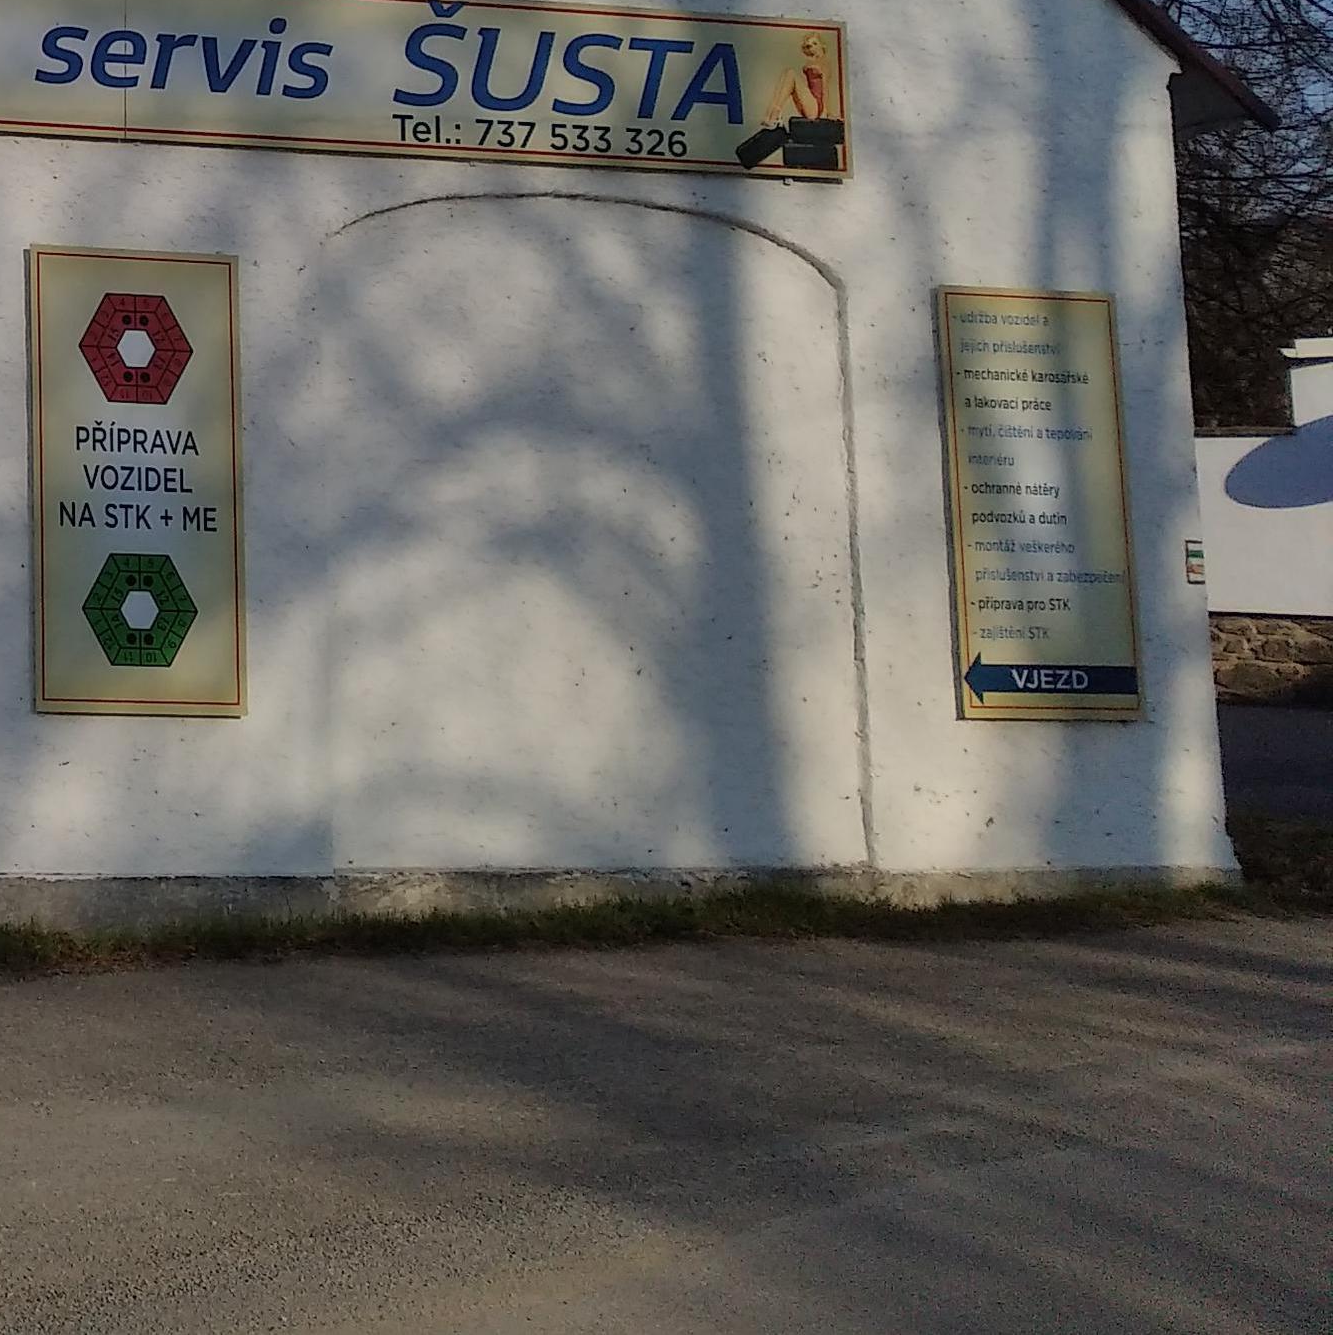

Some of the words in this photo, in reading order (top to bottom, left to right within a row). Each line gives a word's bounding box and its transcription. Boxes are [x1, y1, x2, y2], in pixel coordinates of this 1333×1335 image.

[34, 17, 334, 100] servis
[392, 113, 461, 145] Tel.:
[475, 118, 536, 148] 737
[550, 123, 612, 153] 533
[625, 127, 688, 158] 326
[75, 420, 199, 456] PŘÍPRAVA
[83, 464, 193, 493] VOZIDEL
[59, 501, 96, 527] NA
[104, 503, 152, 530] STK
[160, 509, 173, 526] +
[183, 506, 218, 532] ME
[1027, 601, 1046, 612] pro
[1049, 598, 1071, 611] STK
[1011, 669, 1089, 689] VJEZD
